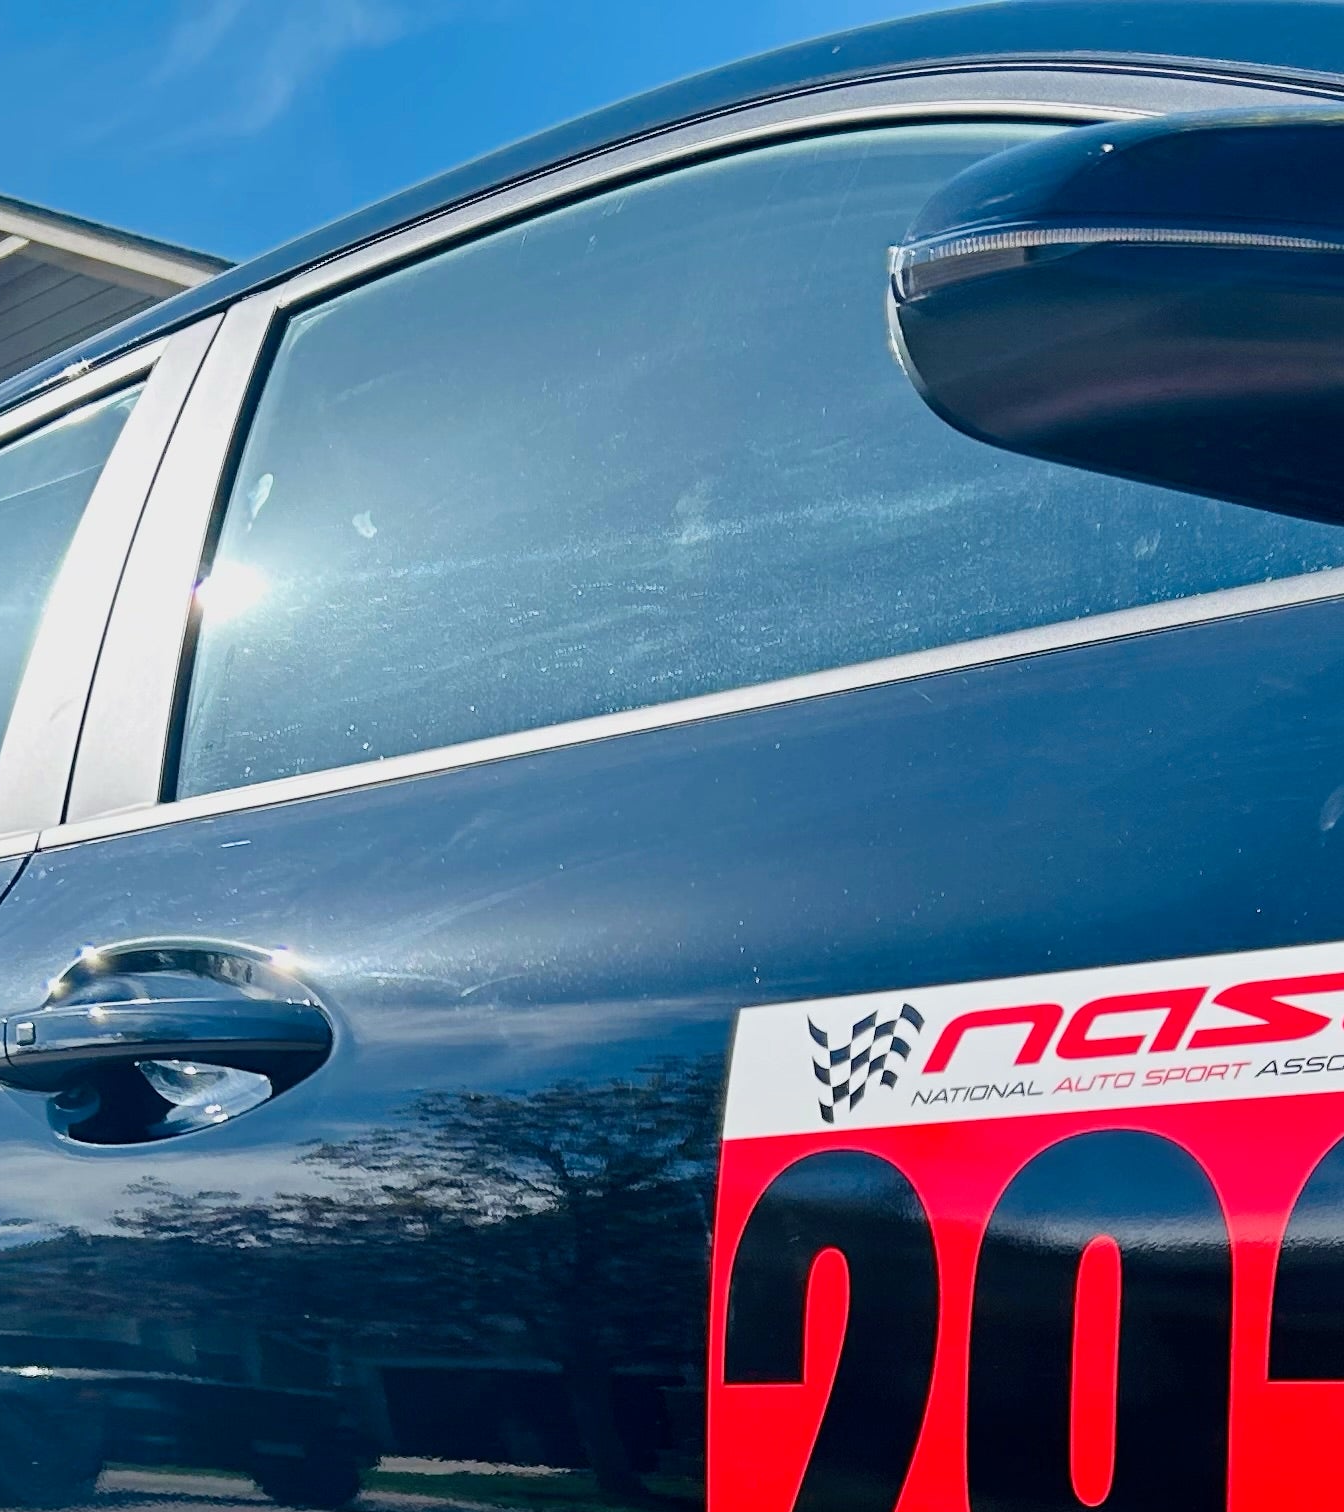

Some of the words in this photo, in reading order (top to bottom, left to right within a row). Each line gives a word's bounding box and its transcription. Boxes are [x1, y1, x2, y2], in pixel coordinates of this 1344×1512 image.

[910, 1080, 1044, 1107] NATIONAL
[1052, 1072, 1135, 1096] AUTO
[1141, 1060, 1253, 1088] SPORT
